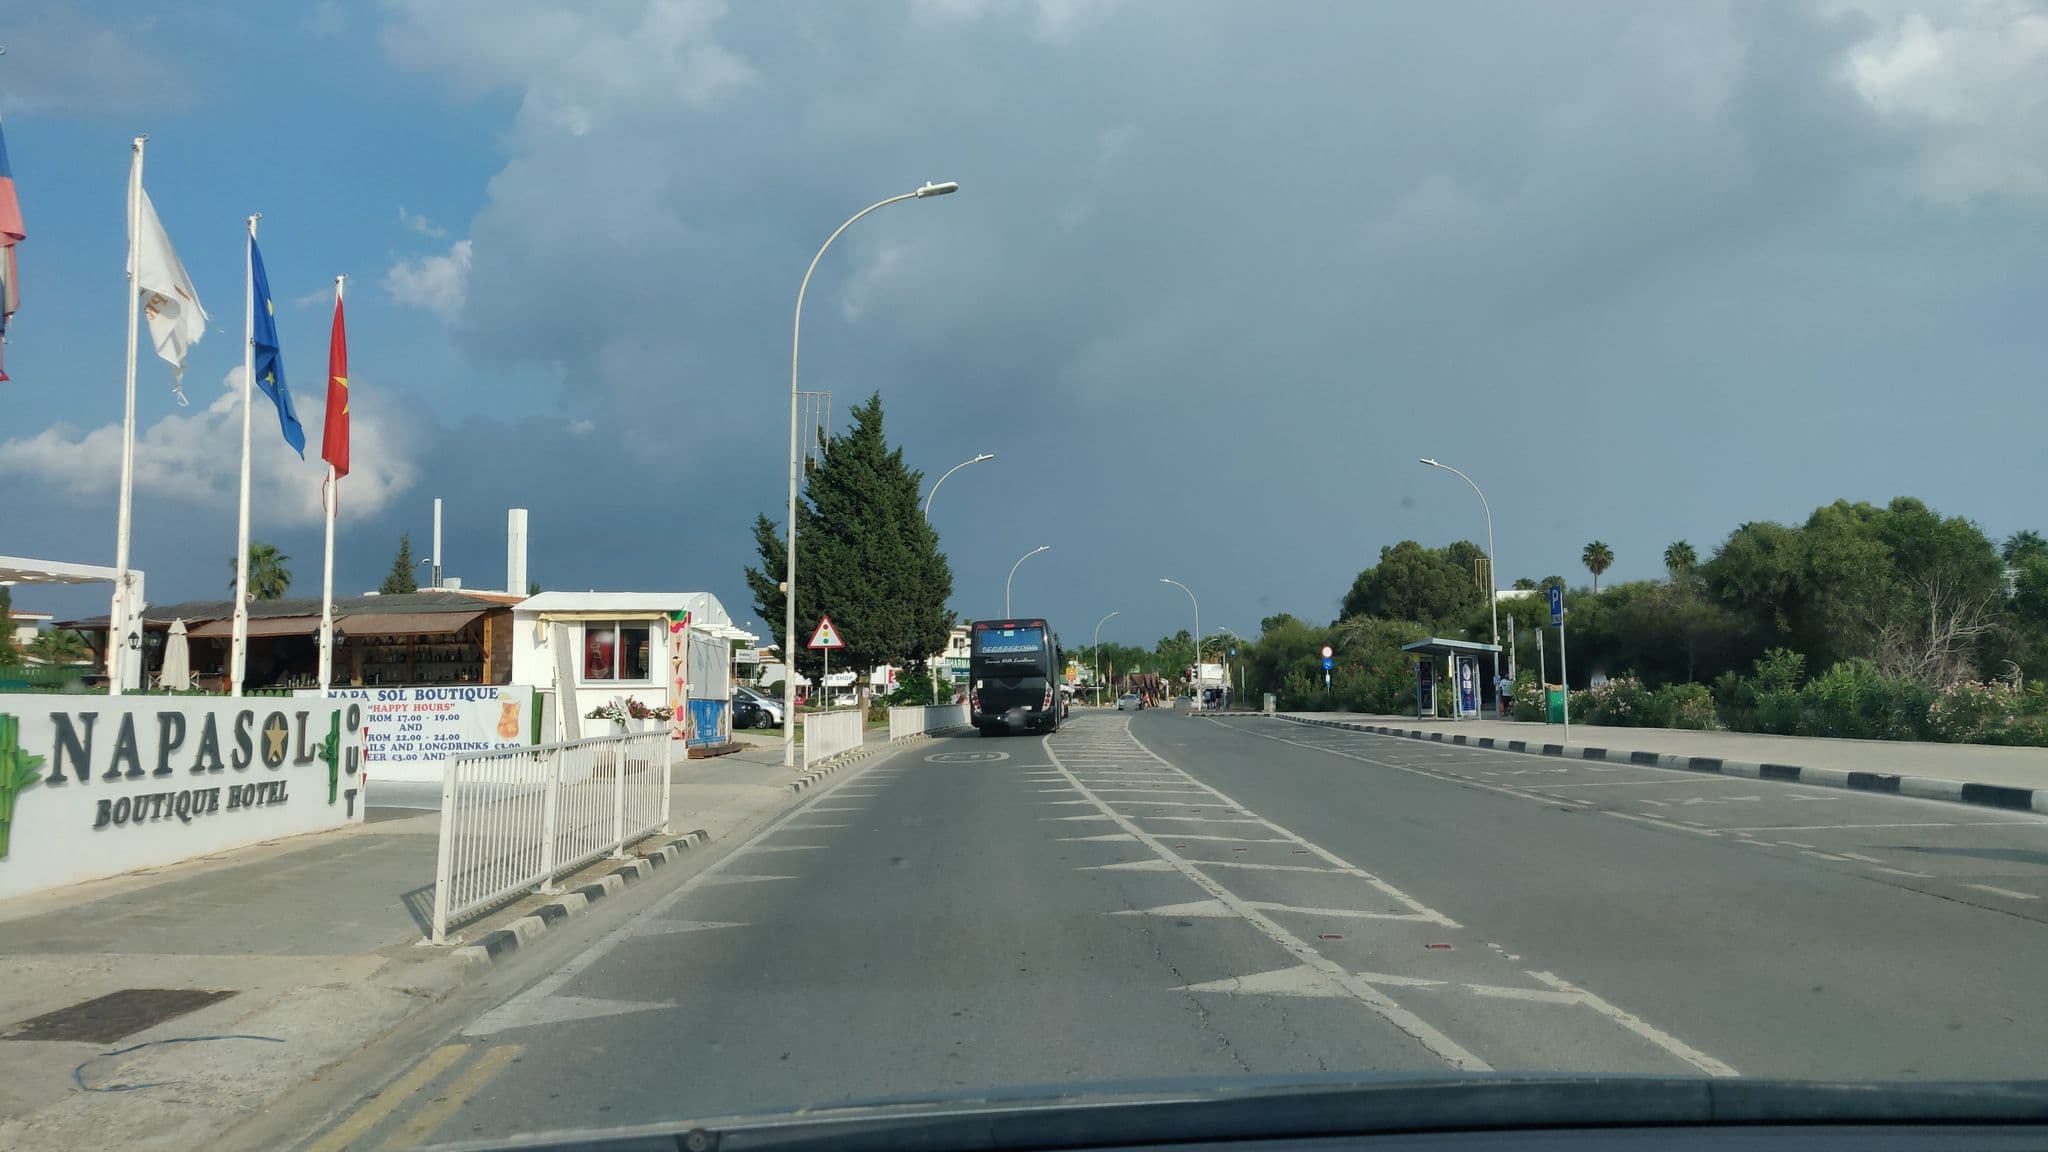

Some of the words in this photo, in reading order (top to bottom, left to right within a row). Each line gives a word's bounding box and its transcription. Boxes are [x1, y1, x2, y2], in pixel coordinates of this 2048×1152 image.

[1552, 589, 1559, 609] P
[377, 690, 407, 701] SOL
[415, 688, 499, 702] BOUTIQUE
[397, 714, 422, 722] 17.00
[399, 723, 423, 731] AND
[45, 710, 316, 785] NAPASOL
[391, 743, 414, 751] AND
[419, 742, 489, 750] LONGDRINKS
[344, 703, 361, 818] OUT
[367, 753, 387, 761] EER
[94, 788, 220, 830] BOUTIQUE
[227, 780, 289, 809] HOTEL
